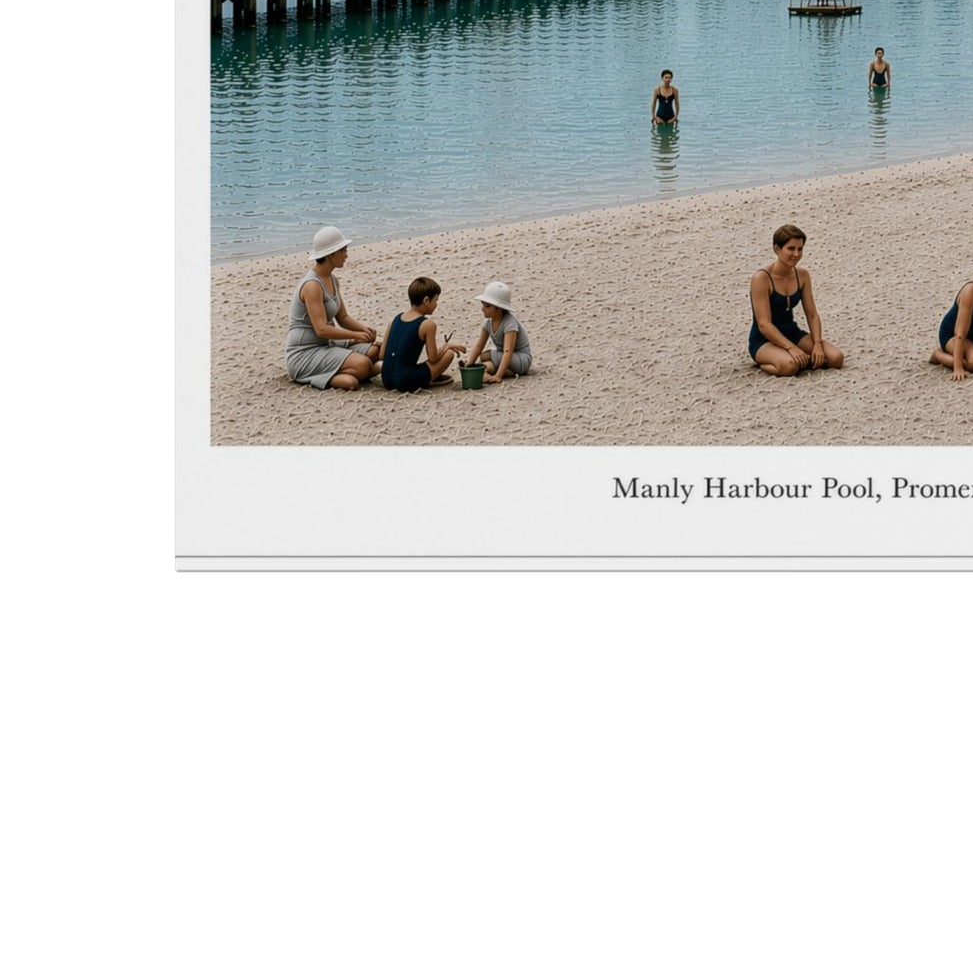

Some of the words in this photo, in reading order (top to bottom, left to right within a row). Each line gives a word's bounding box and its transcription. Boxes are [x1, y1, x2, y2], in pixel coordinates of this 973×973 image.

[612, 476, 694, 504] Manly
[704, 476, 812, 499] Harbour
[822, 476, 882, 504] Pool,
